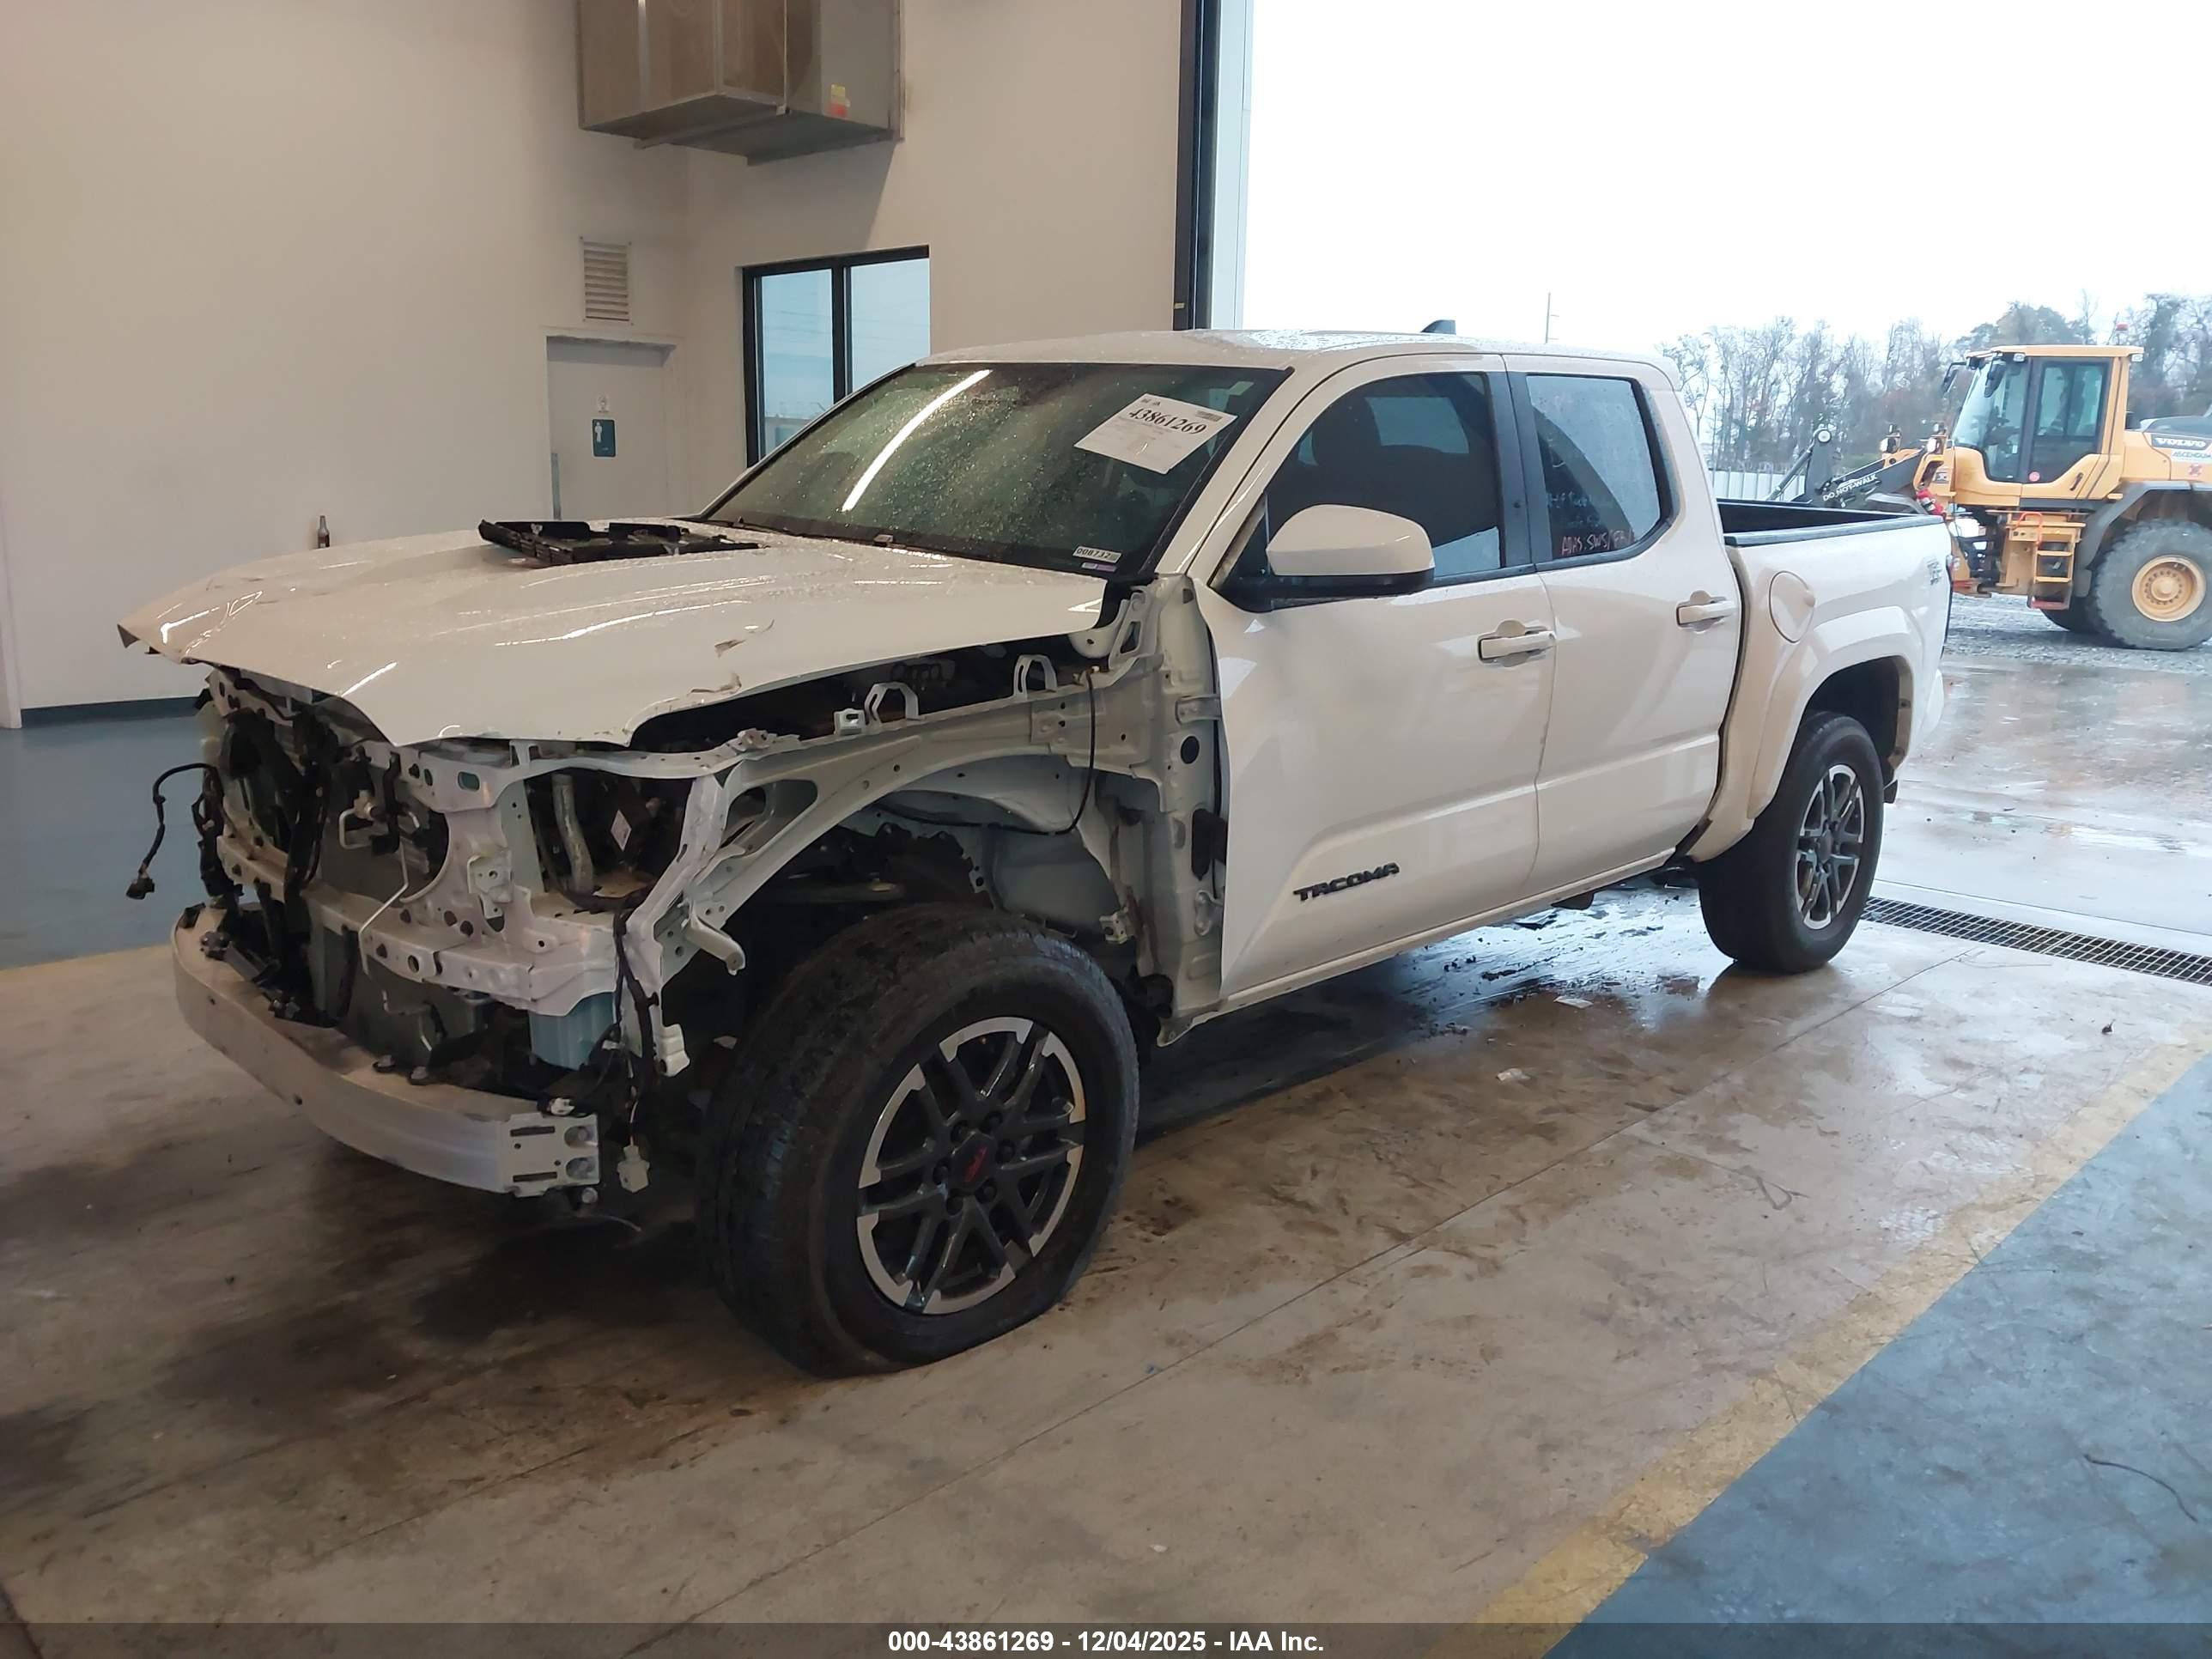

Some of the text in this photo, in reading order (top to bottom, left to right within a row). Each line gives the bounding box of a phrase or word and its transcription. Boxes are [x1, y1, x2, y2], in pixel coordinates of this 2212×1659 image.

[1129, 408, 1207, 434] 43861269
[2154, 437, 2207, 447] VOLVO
[1822, 492, 1835, 501] DO
[1853, 474, 1879, 488] WALK
[1293, 862, 1400, 902] TACOMA
